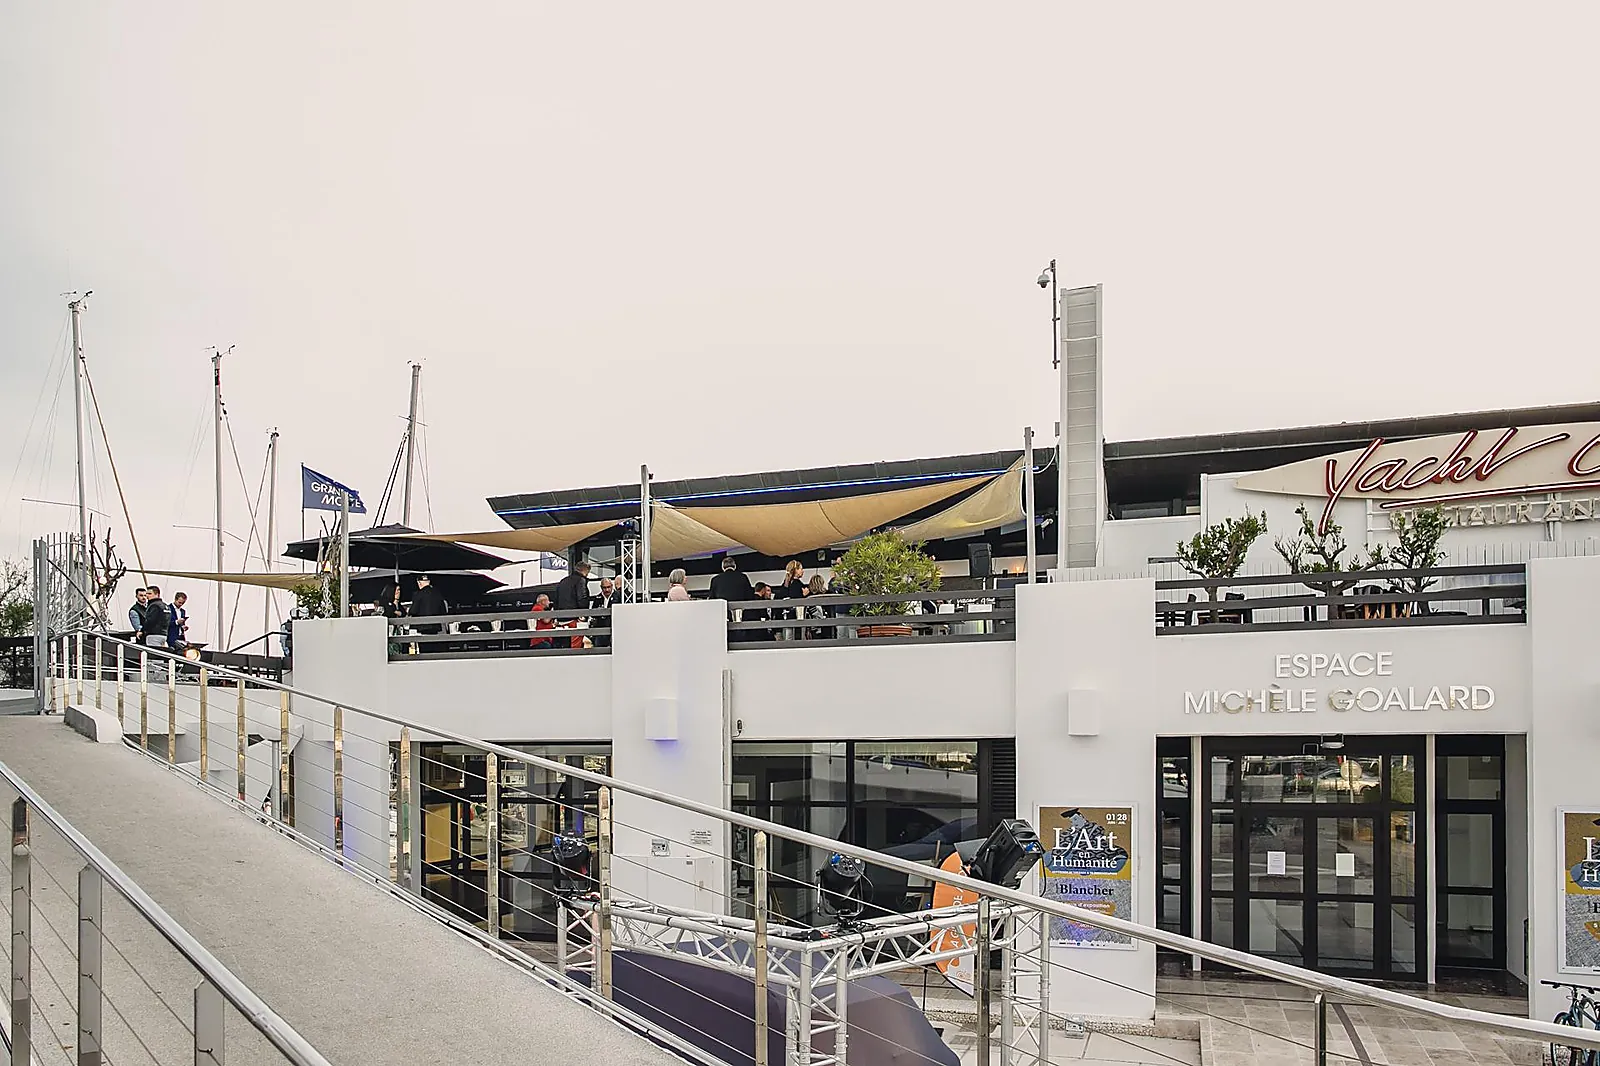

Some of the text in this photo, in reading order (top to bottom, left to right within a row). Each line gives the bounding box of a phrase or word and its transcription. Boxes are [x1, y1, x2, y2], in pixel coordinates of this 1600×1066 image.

[1318, 426, 1571, 537] Yacht
[321, 494, 361, 508] MOE
[1390, 497, 1597, 528] TAURAN
[1275, 651, 1393, 678] ESPACE
[1184, 683, 1495, 714] MICHÈLE GOALARD
[1116, 813, 1127, 821] 28
[1052, 827, 1118, 851] L'Art
[1052, 855, 1118, 868] Humanité
[1078, 851, 1091, 859] en
[1060, 883, 1115, 896] Blancher
